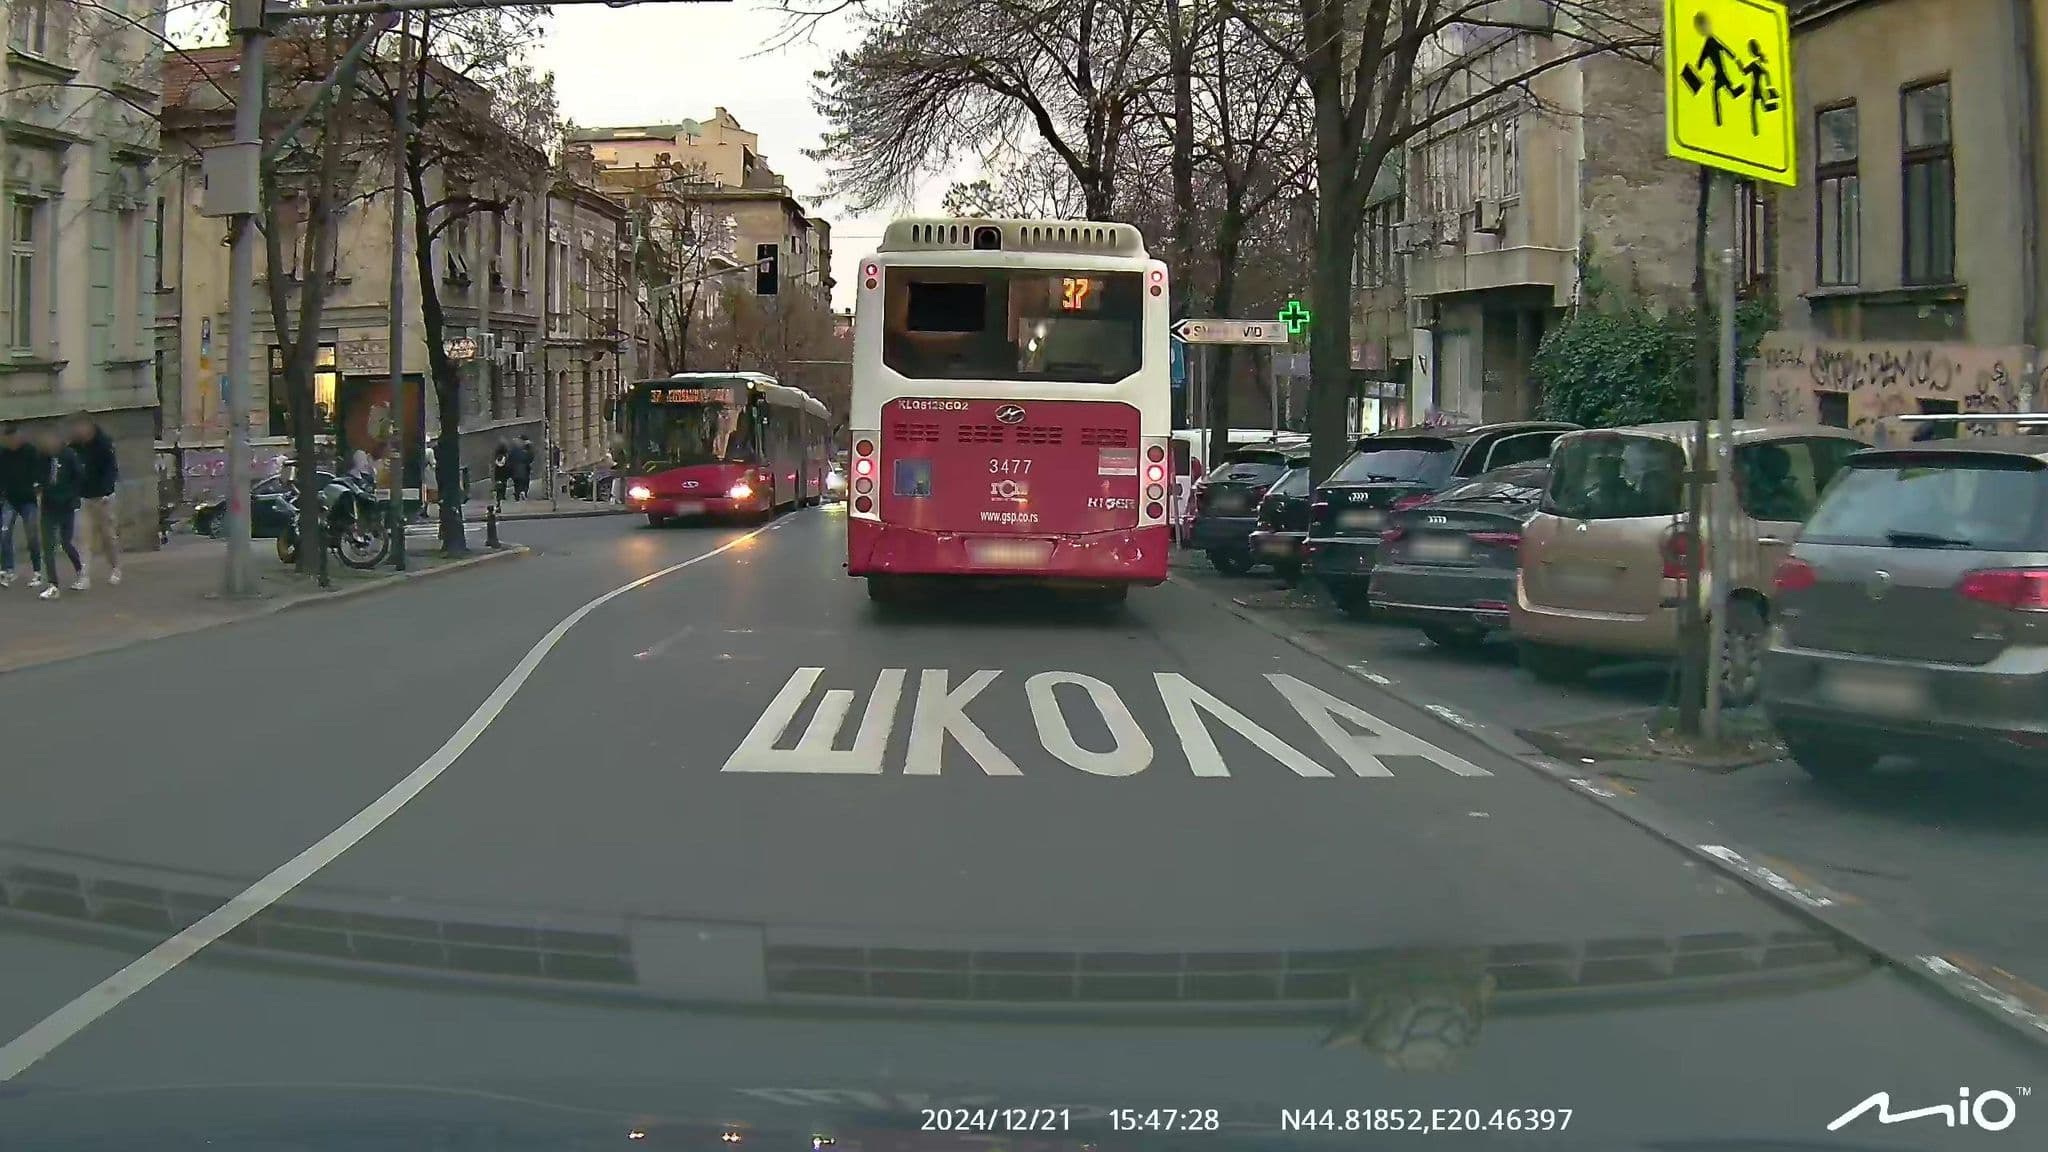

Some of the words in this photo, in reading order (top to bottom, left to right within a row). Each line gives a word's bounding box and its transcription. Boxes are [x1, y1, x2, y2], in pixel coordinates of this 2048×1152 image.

[1062, 278, 1088, 309] 37
[989, 458, 1032, 474] 3477
[980, 511, 1039, 525] www.gsp.co.rs
[720, 666, 1495, 777] ШКОЛА
